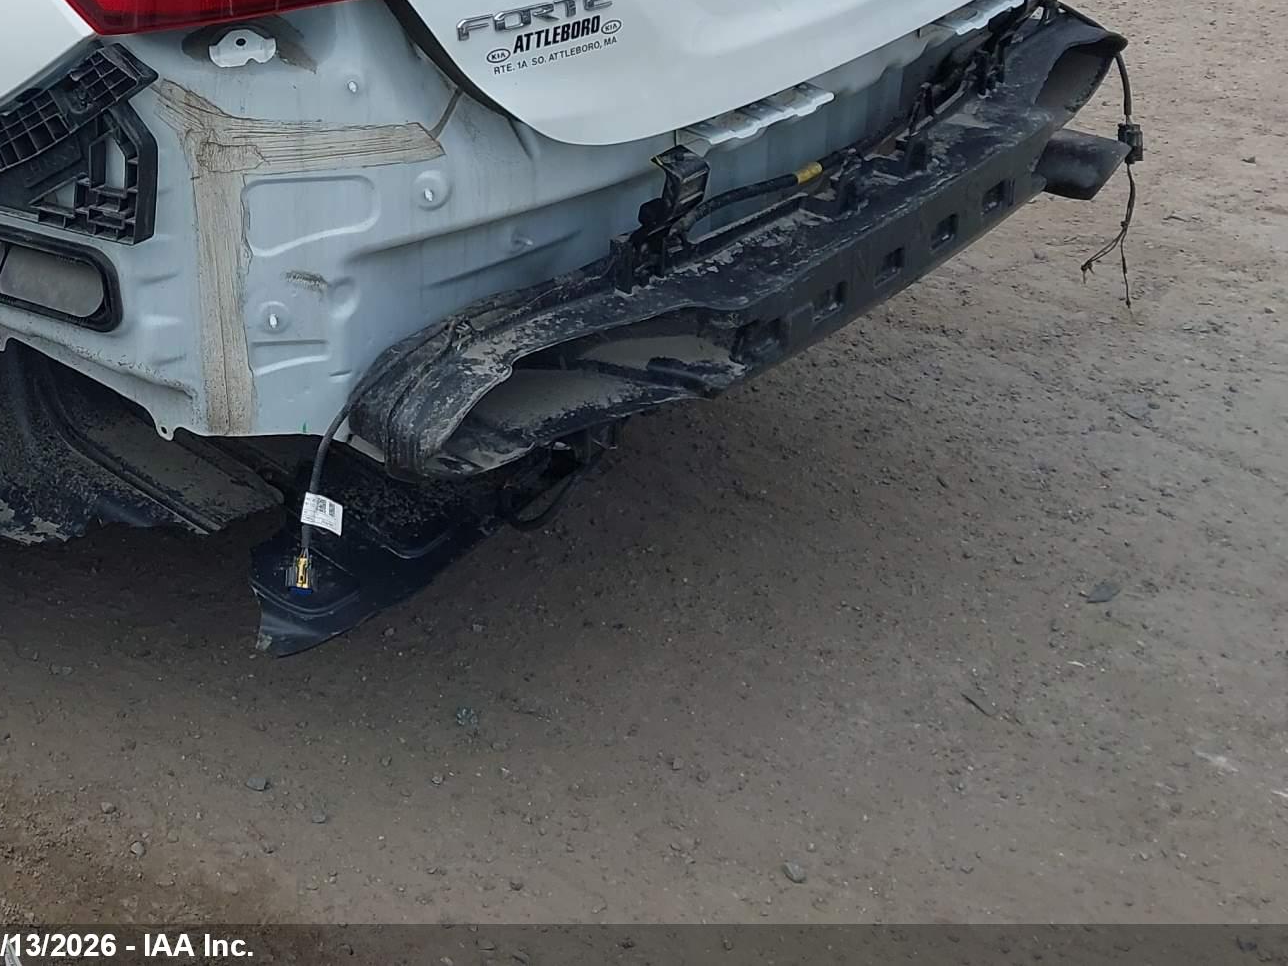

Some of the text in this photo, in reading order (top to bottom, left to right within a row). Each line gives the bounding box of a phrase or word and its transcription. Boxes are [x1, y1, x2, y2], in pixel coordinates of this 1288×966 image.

[513, 15, 601, 54] ATTLEBORO
[494, 35, 618, 75] RTE. 1A SO. ATTLEBORO, MA
